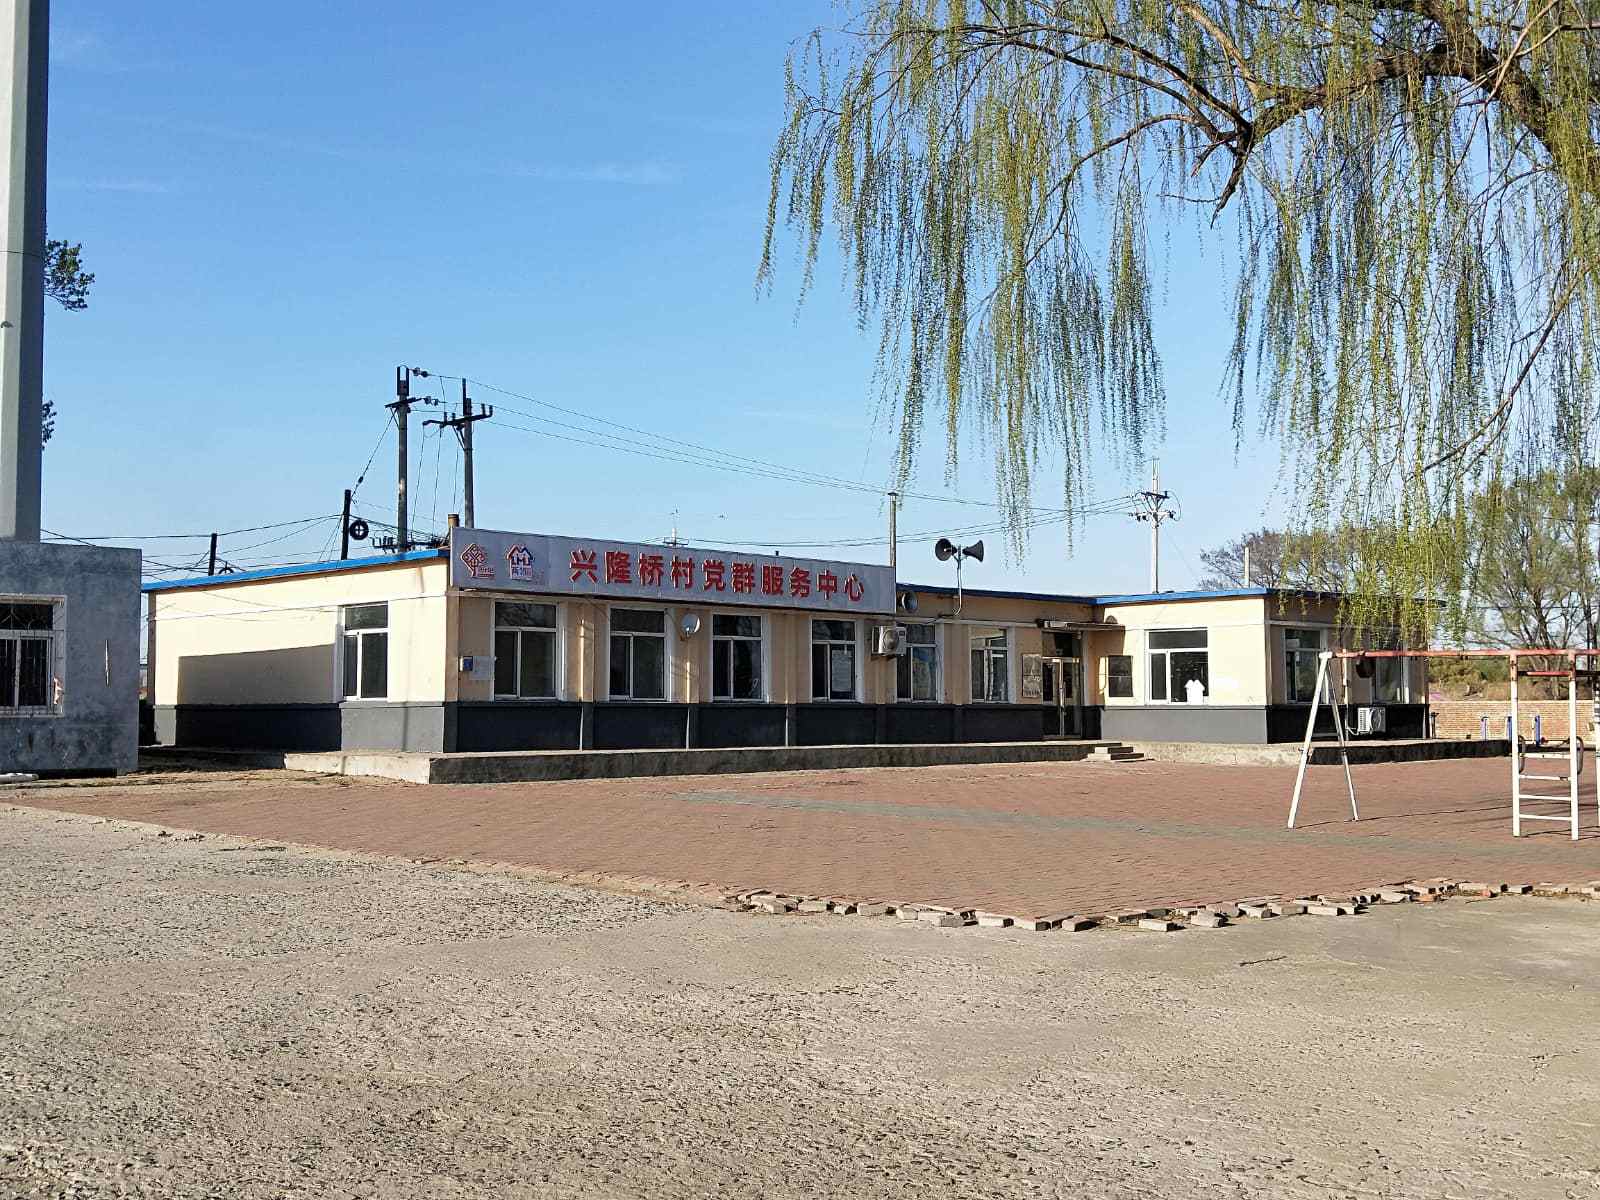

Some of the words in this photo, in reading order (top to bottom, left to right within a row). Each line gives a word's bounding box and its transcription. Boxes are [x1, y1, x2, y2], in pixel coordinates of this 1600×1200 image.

[569, 549, 865, 601] 兴隆桥村党群服务中心
